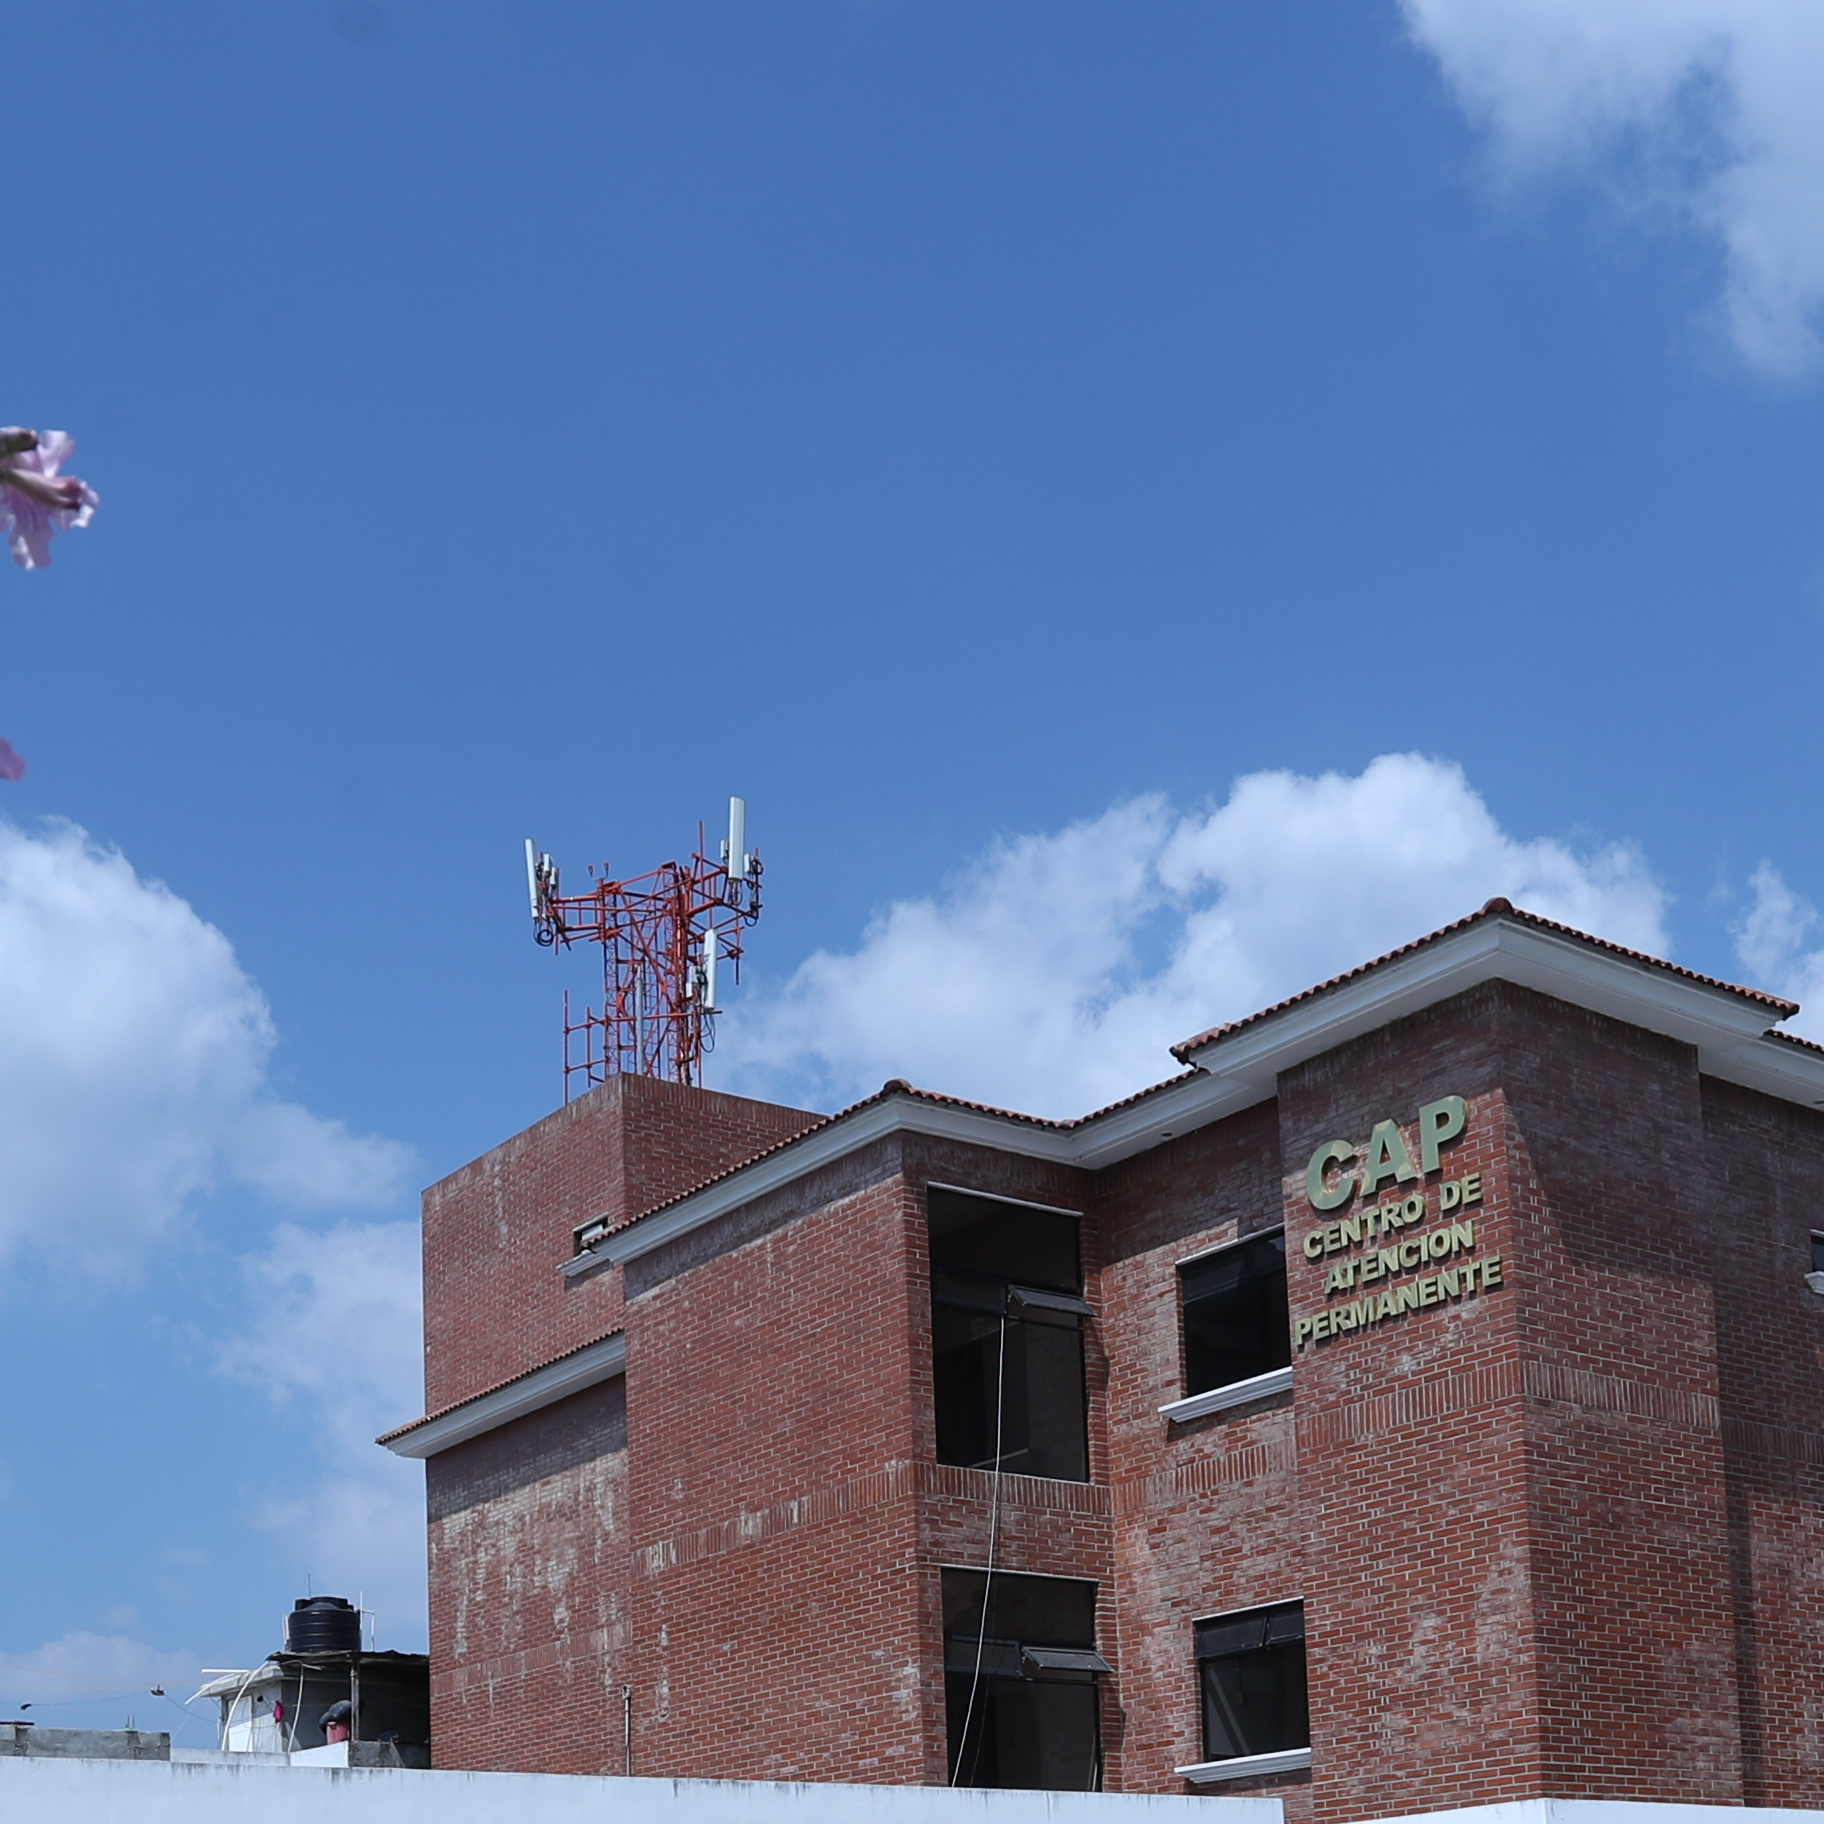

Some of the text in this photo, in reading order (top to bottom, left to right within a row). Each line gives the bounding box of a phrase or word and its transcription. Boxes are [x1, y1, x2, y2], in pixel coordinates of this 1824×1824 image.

[1306, 1094, 1469, 1211] CAP
[1303, 1172, 1483, 1259] CENTRO DE
[1323, 1219, 1475, 1295] ATENCION
[1294, 1256, 1503, 1346] PERMANENTE
